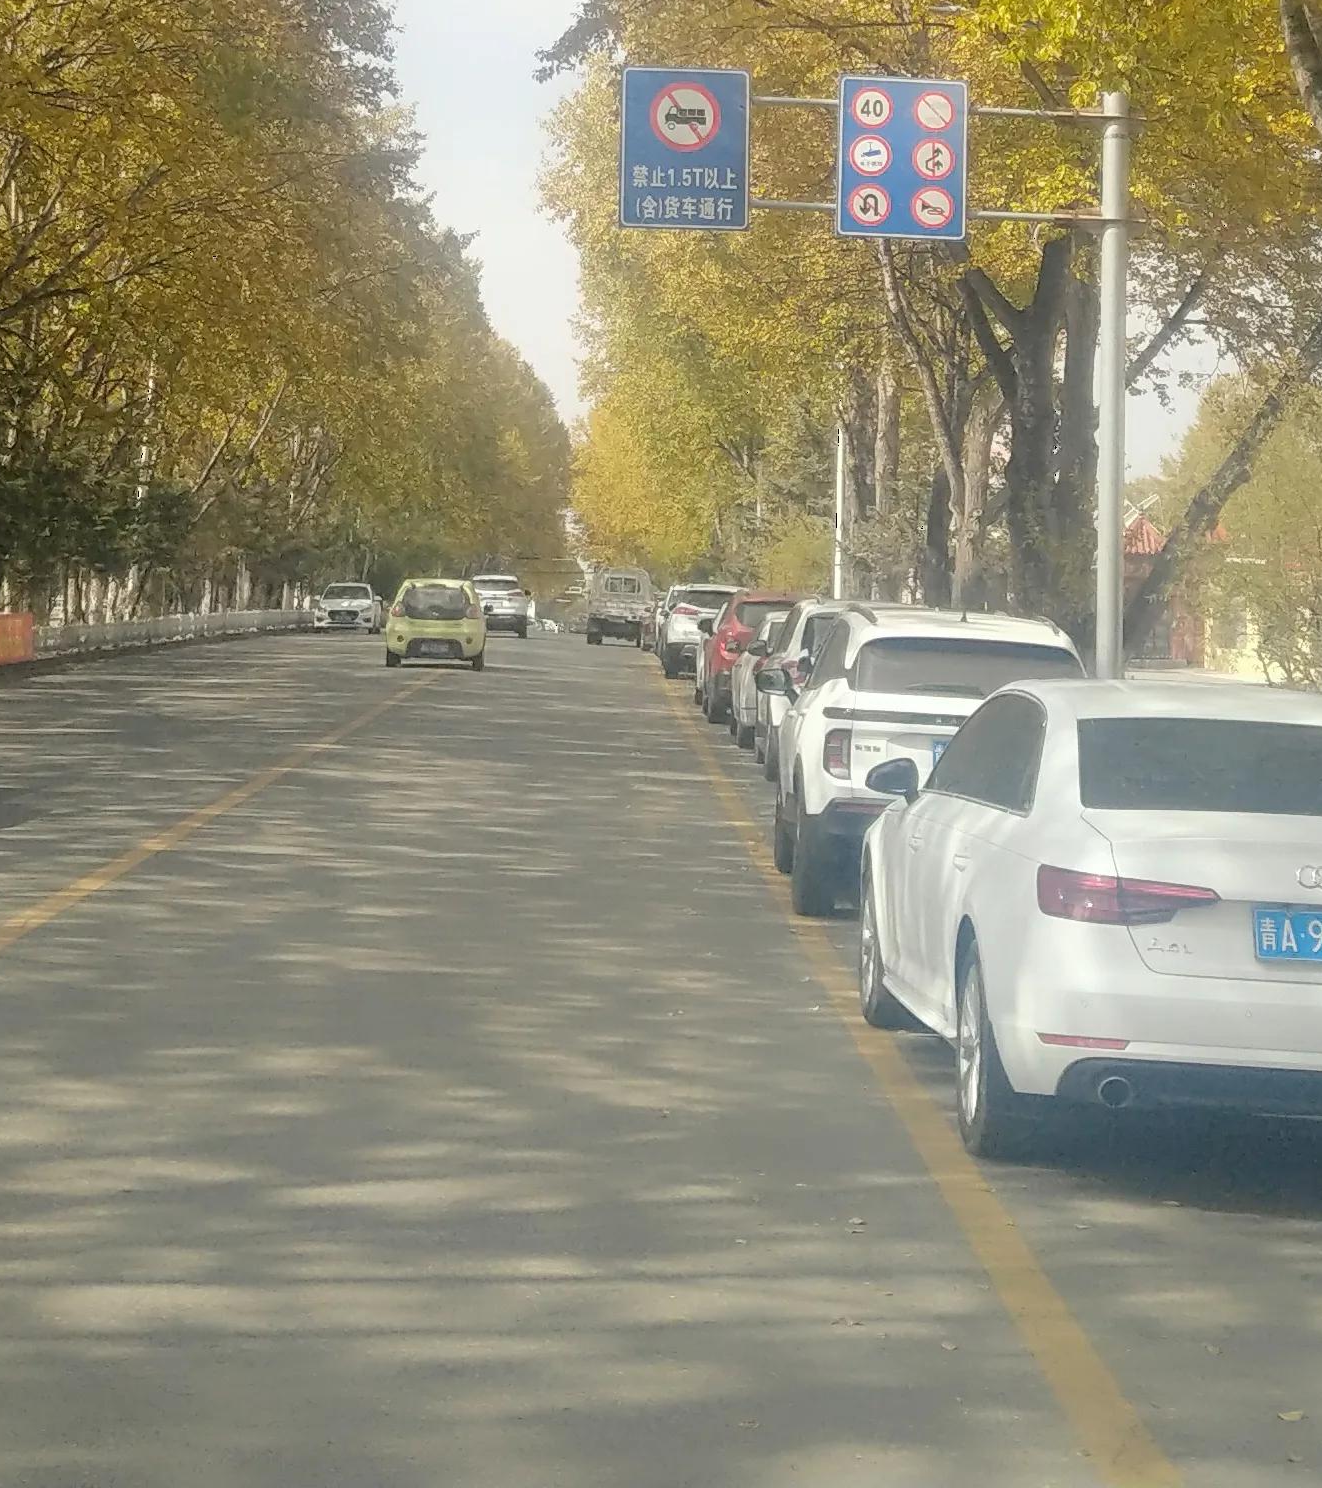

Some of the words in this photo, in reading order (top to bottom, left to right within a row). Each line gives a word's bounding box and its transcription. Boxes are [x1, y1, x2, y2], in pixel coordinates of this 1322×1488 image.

[860, 98, 884, 118] 40
[632, 164, 738, 190] 禁止1.5T以上
[636, 195, 734, 221] (含)货车通行
